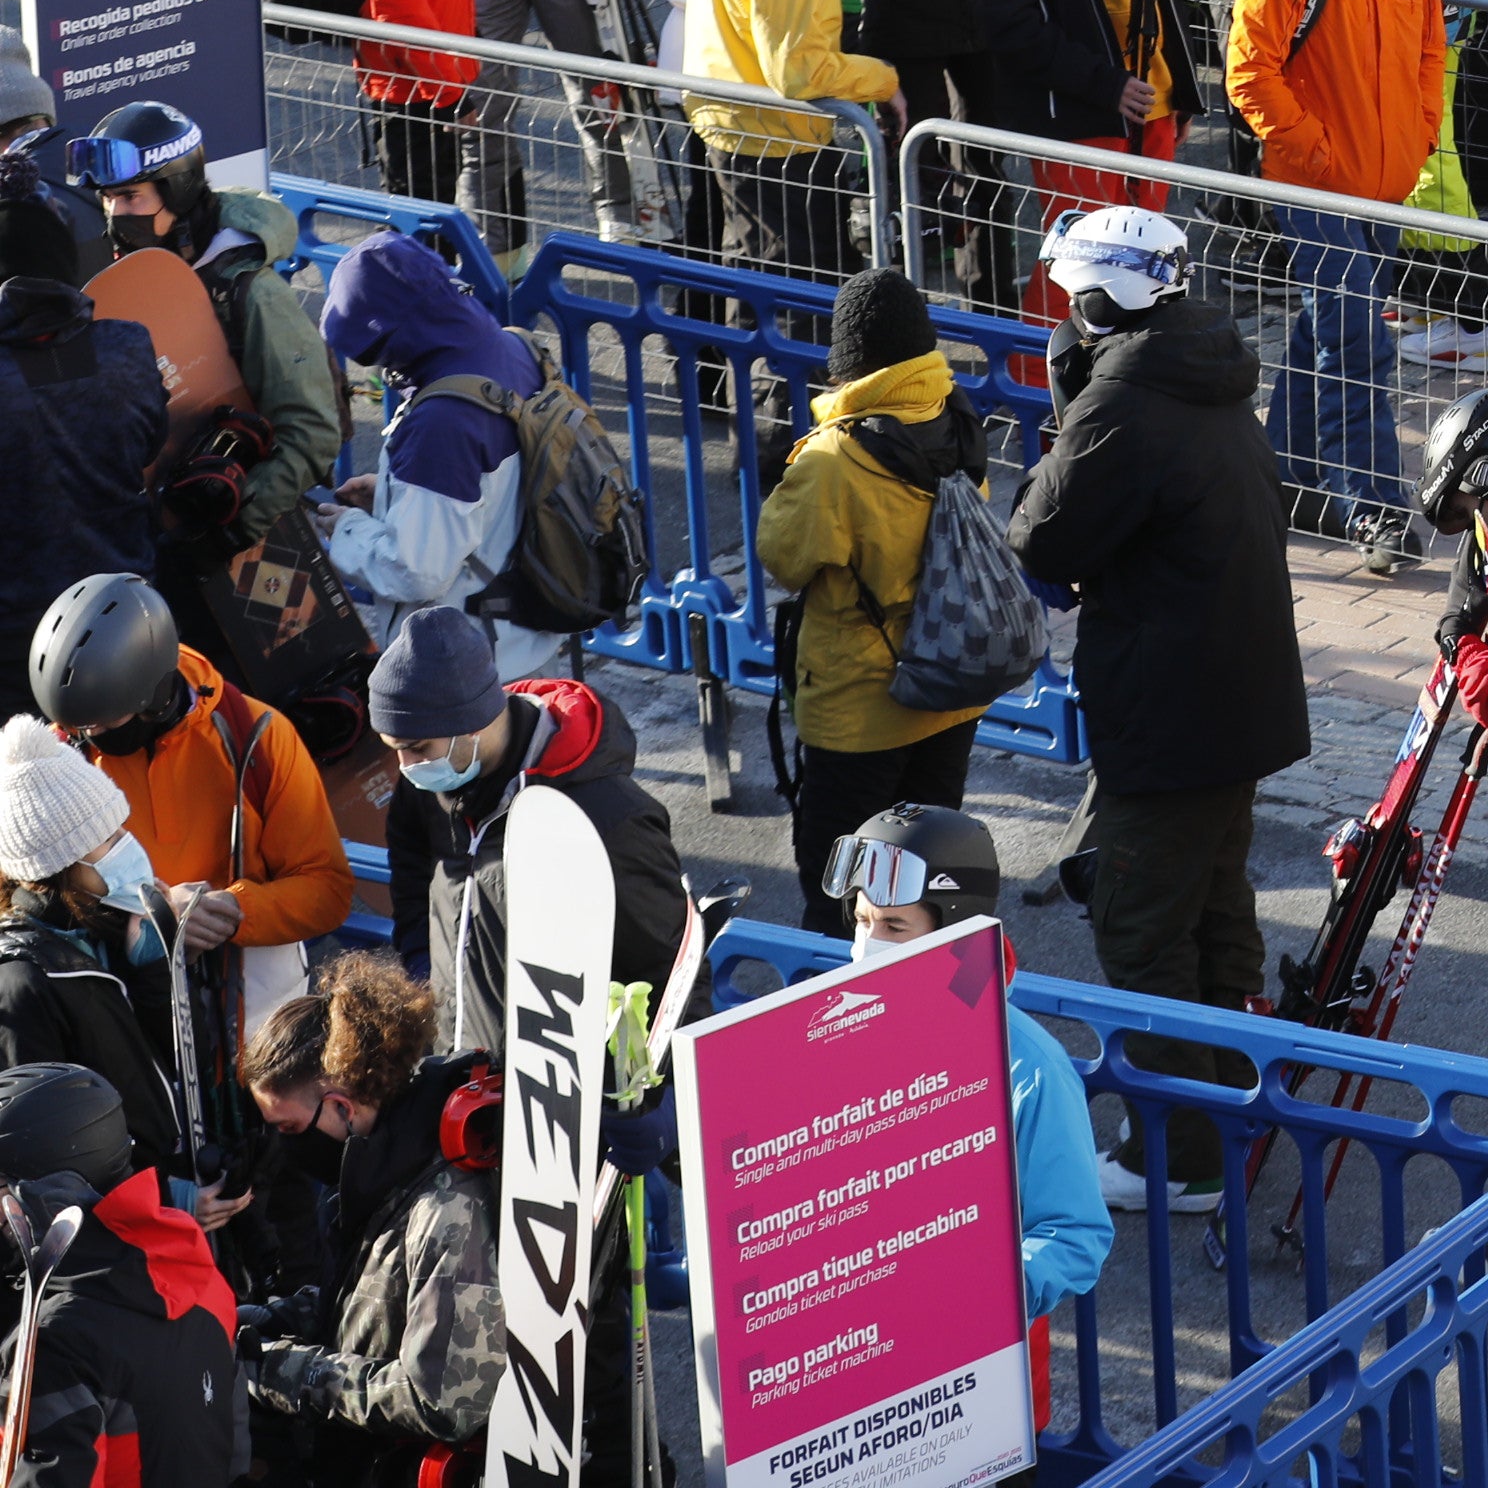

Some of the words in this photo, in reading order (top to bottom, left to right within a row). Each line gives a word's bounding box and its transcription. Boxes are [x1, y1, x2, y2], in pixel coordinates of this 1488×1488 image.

[60, 6, 130, 37] Recogida
[61, 32, 96, 52] Online
[97, 25, 129, 44] order
[129, 12, 182, 35] collection
[63, 63, 112, 87] Bonos
[114, 56, 134, 74] de
[63, 85, 97, 102] Travel
[97, 72, 138, 94] agency
[139, 59, 190, 83] vouchers
[806, 1003, 886, 1043] sierranevada
[731, 1131, 809, 1170] Compra
[812, 1095, 875, 1141] forfait
[880, 1089, 898, 1113] de
[908, 1069, 948, 1100] días
[734, 1163, 774, 1189] Single
[776, 1150, 801, 1173] and
[803, 1125, 863, 1160] multi-day
[864, 1116, 897, 1142] pass
[898, 1102, 928, 1125] days
[930, 1077, 989, 1118] purchase
[737, 1199, 814, 1244] Compra
[818, 1168, 881, 1209] forfait
[884, 1157, 918, 1189] por
[921, 1125, 997, 1170] recarga
[739, 1234, 784, 1263] Reload
[786, 1221, 816, 1245] your
[818, 1210, 837, 1231] ski
[837, 1199, 869, 1224] pass
[742, 1269, 819, 1314] Compra
[822, 1248, 874, 1274] tique
[877, 1203, 979, 1258] telecabina
[745, 1299, 798, 1333] Gondola
[800, 1286, 837, 1314] ticket
[838, 1260, 897, 1300] purchase
[748, 1356, 799, 1391] Pago
[803, 1322, 878, 1370] parking
[751, 1379, 799, 1409] Parking
[802, 1366, 838, 1389] ticket
[840, 1339, 894, 1374] machine
[769, 1423, 850, 1475] FORFAIT
[852, 1371, 977, 1446] DISPONIBLES
[789, 1448, 854, 1488] SEGUN
[858, 1401, 965, 1462] AFORO/DIA
[852, 1447, 918, 1485] AVAILABLE
[919, 1441, 938, 1460] ON
[939, 1423, 974, 1454] DAILY
